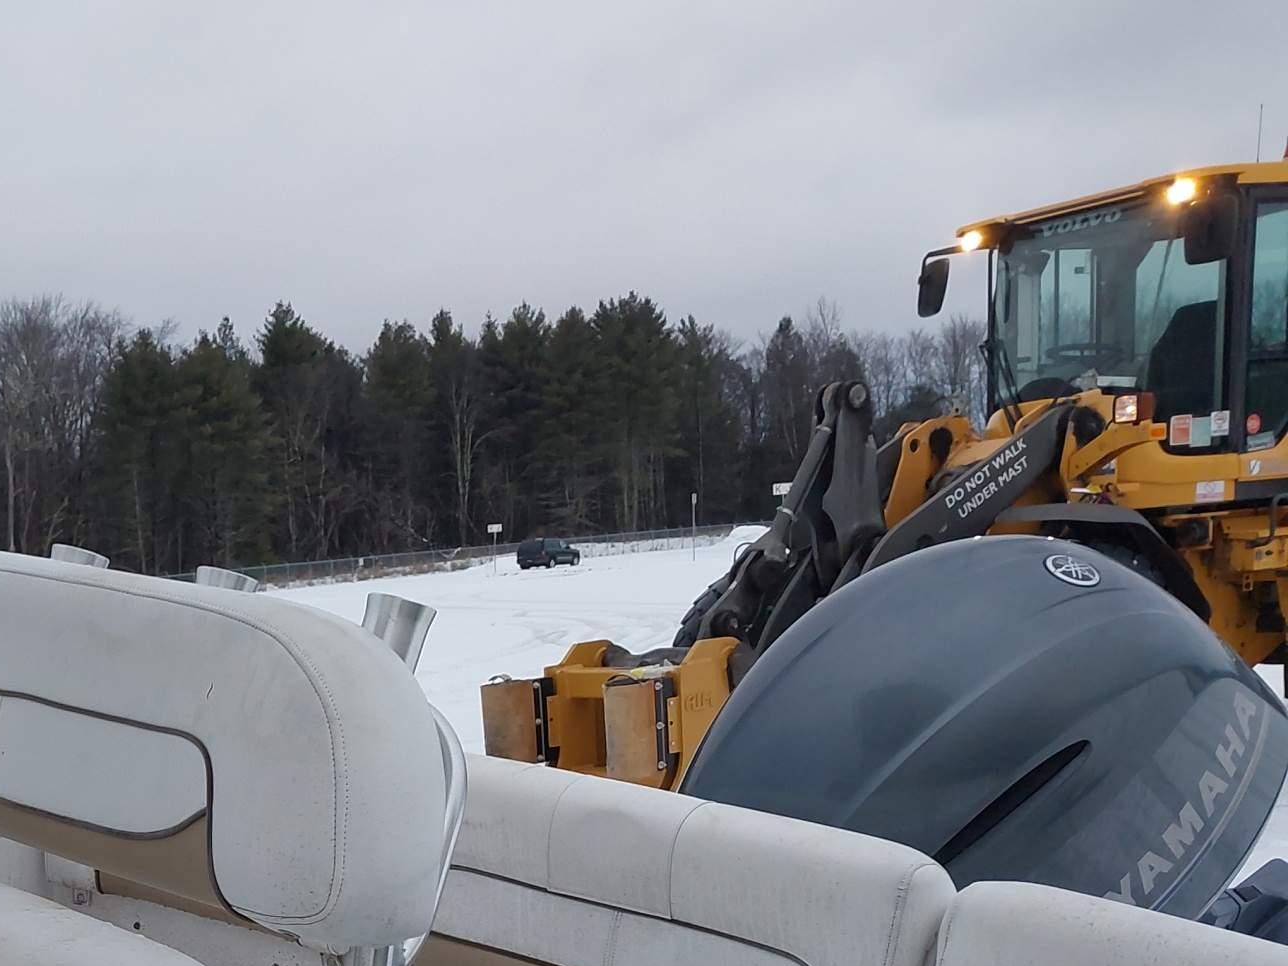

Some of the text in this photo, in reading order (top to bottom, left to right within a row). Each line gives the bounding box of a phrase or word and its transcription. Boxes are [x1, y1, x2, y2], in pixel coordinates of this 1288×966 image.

[1039, 207, 1122, 237] VOLVO
[944, 437, 1027, 509] DO NOT WALK
[957, 455, 1028, 518] UNDER MAST
[1103, 690, 1257, 906] YAMAHA
